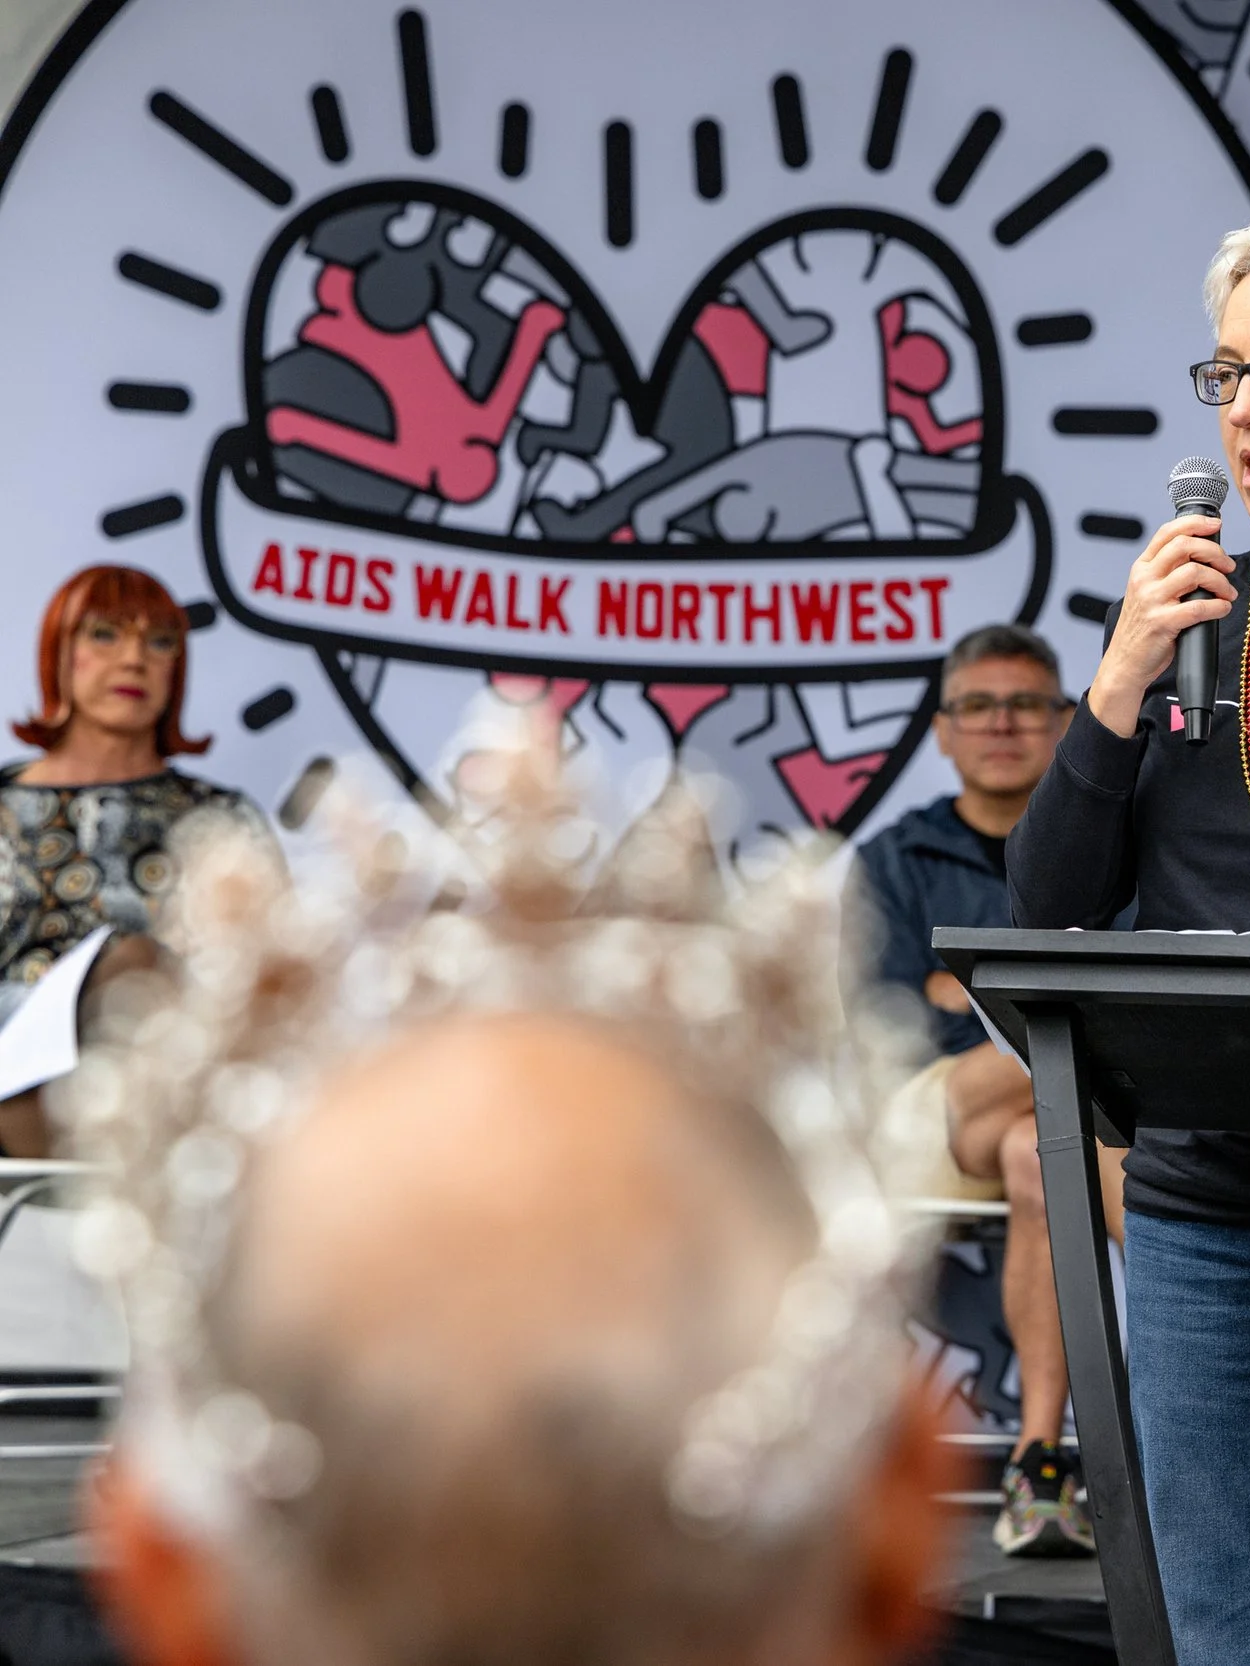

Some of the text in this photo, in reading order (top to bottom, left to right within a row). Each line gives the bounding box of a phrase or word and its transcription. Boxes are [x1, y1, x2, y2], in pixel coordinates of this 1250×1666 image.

[252, 543, 950, 643] AIDS WALK NORTHWEST
